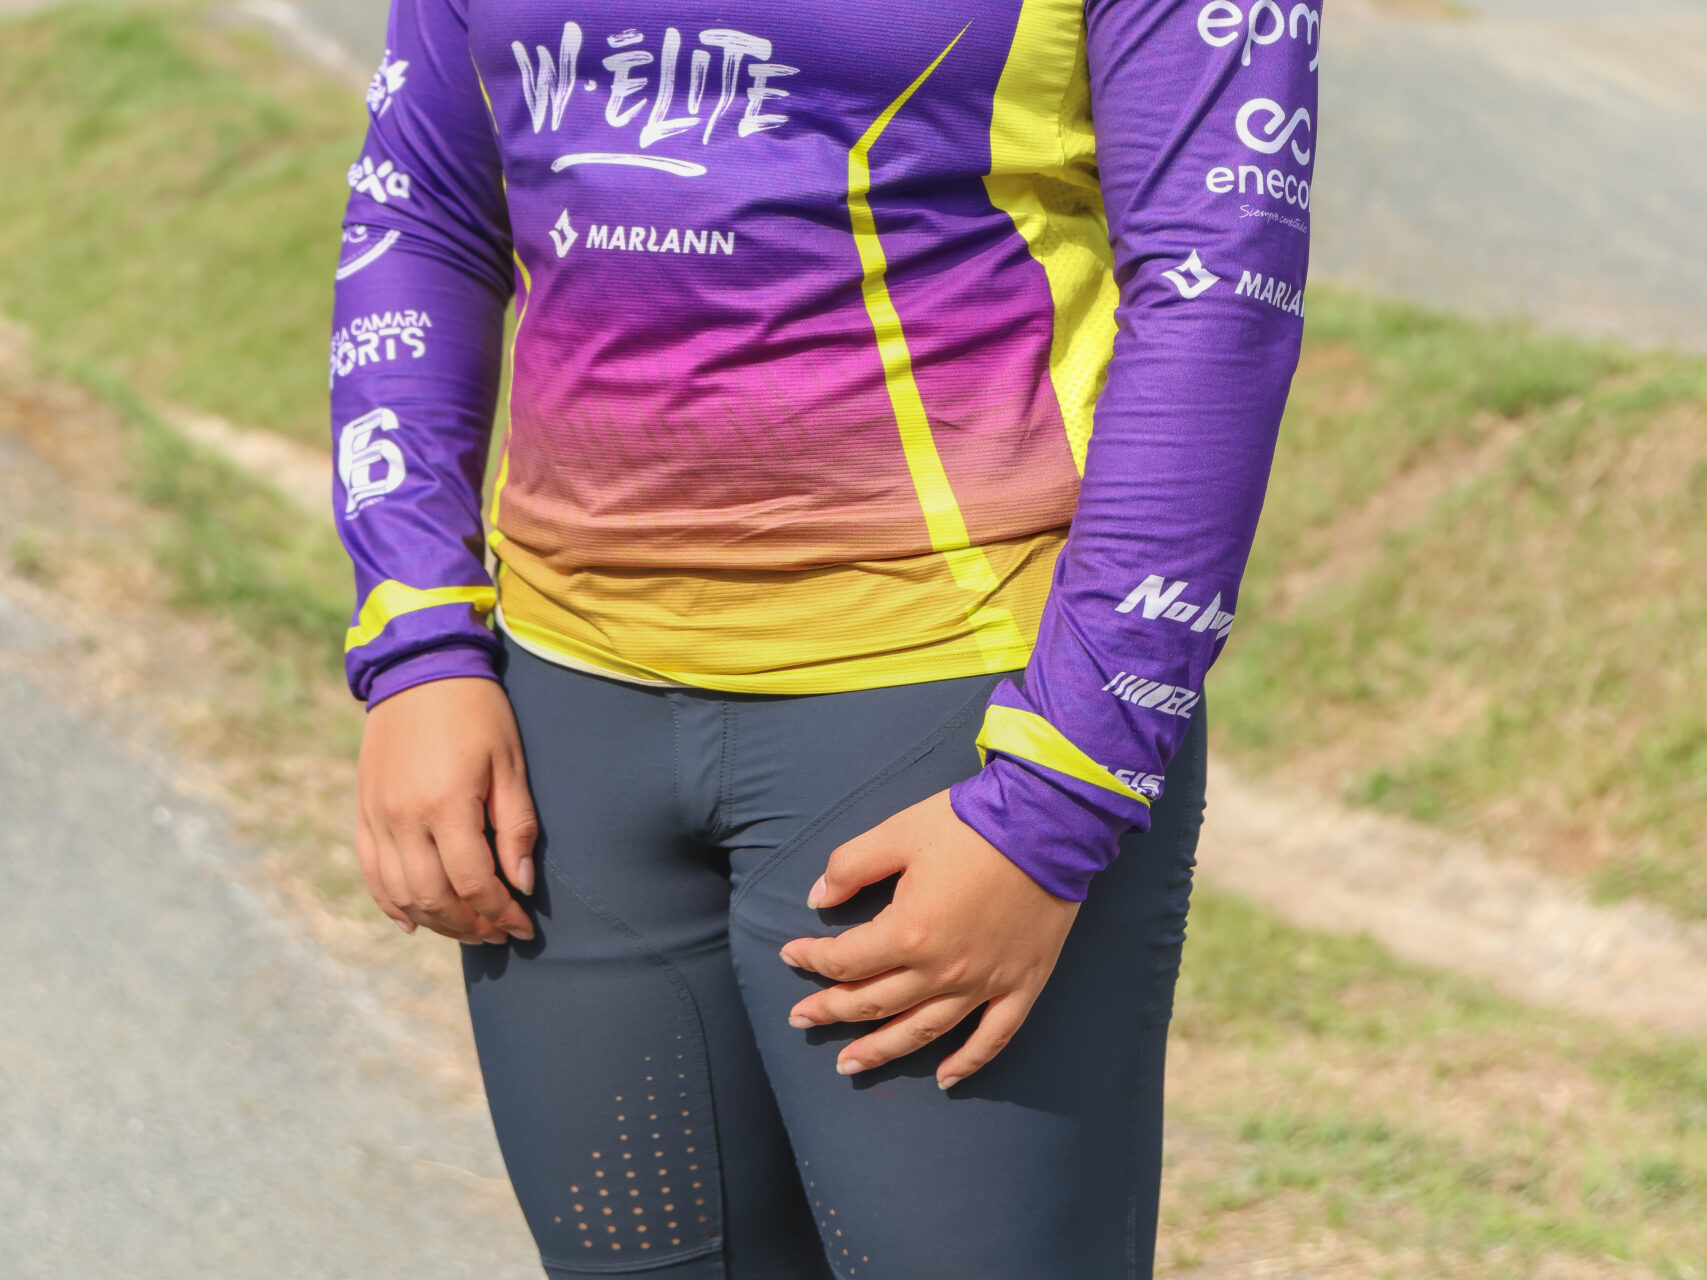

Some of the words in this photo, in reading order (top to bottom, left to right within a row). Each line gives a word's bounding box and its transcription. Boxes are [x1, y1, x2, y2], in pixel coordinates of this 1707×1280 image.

[1206, 165, 1311, 212] eneco
[585, 224, 735, 255] MARLANN
[1234, 270, 1305, 318] MARLA
